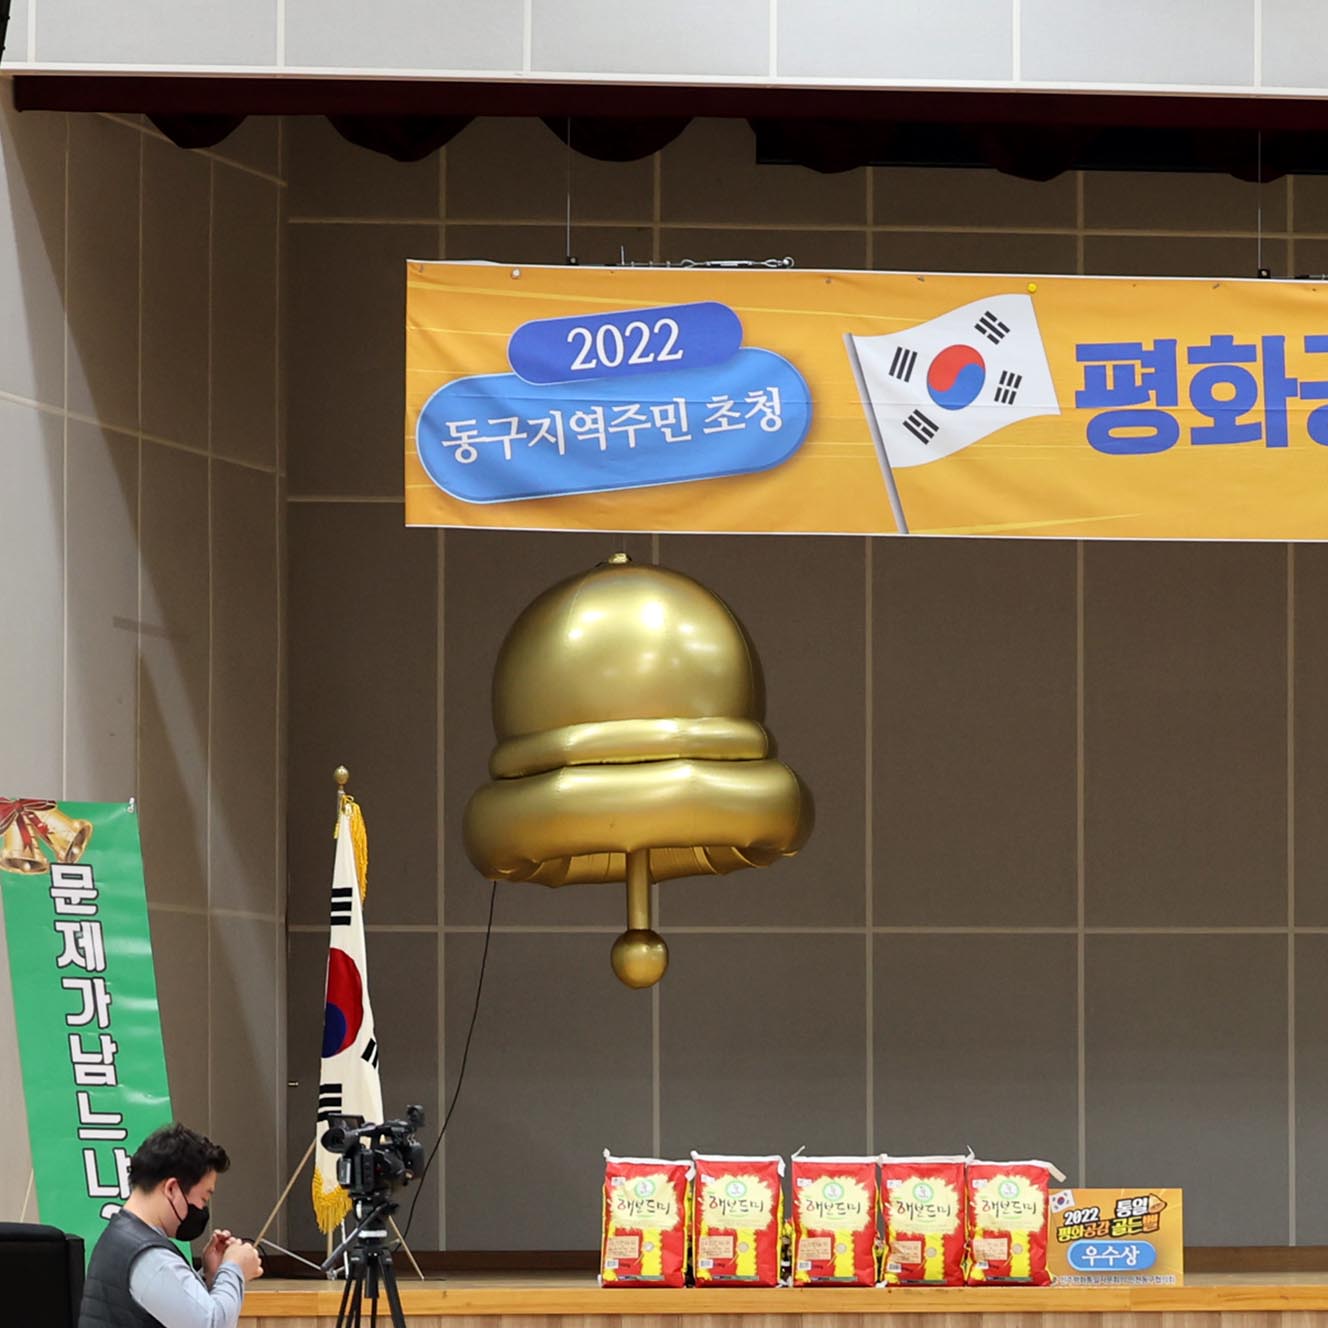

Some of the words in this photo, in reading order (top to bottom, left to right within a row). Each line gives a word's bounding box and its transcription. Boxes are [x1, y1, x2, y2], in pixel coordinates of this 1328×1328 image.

[567, 318, 683, 371] 2022
[442, 397, 691, 463] 동구지역주민
[702, 386, 784, 435] 초청
[1065, 1207, 1099, 1225] 2022
[1116, 1197, 1149, 1217] 통일
[1058, 1221, 1109, 1242] 평화공감
[1082, 1245, 1140, 1266] 우수상
